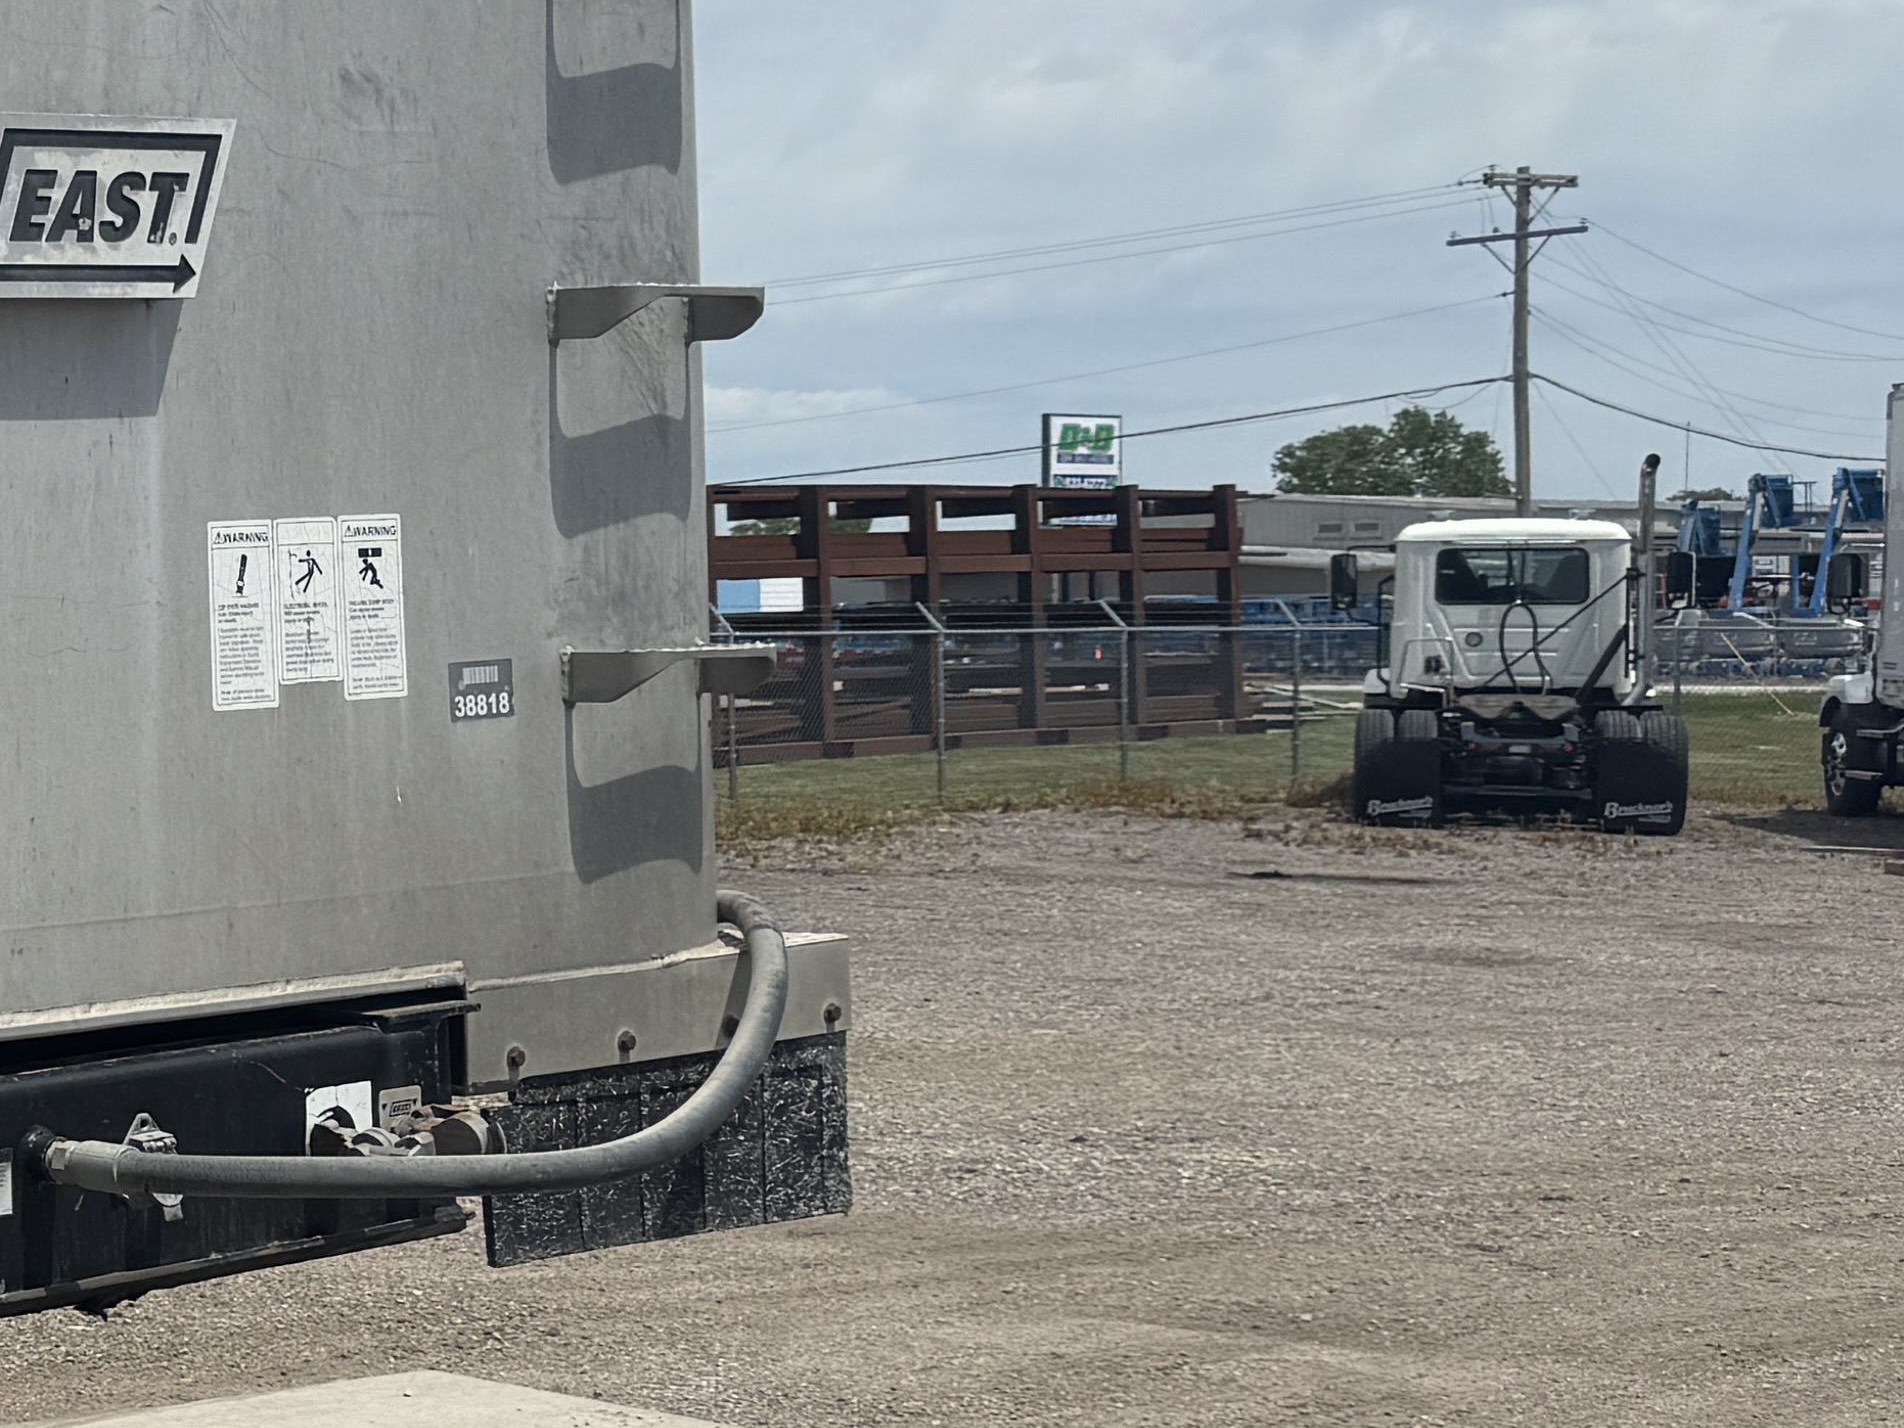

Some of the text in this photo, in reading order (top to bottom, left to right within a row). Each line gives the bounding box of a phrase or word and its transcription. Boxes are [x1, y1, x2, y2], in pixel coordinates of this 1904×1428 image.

[9, 168, 190, 244] EAST
[223, 531, 269, 544] WARNING
[353, 525, 396, 536] WARNING
[454, 692, 510, 718] 38818
